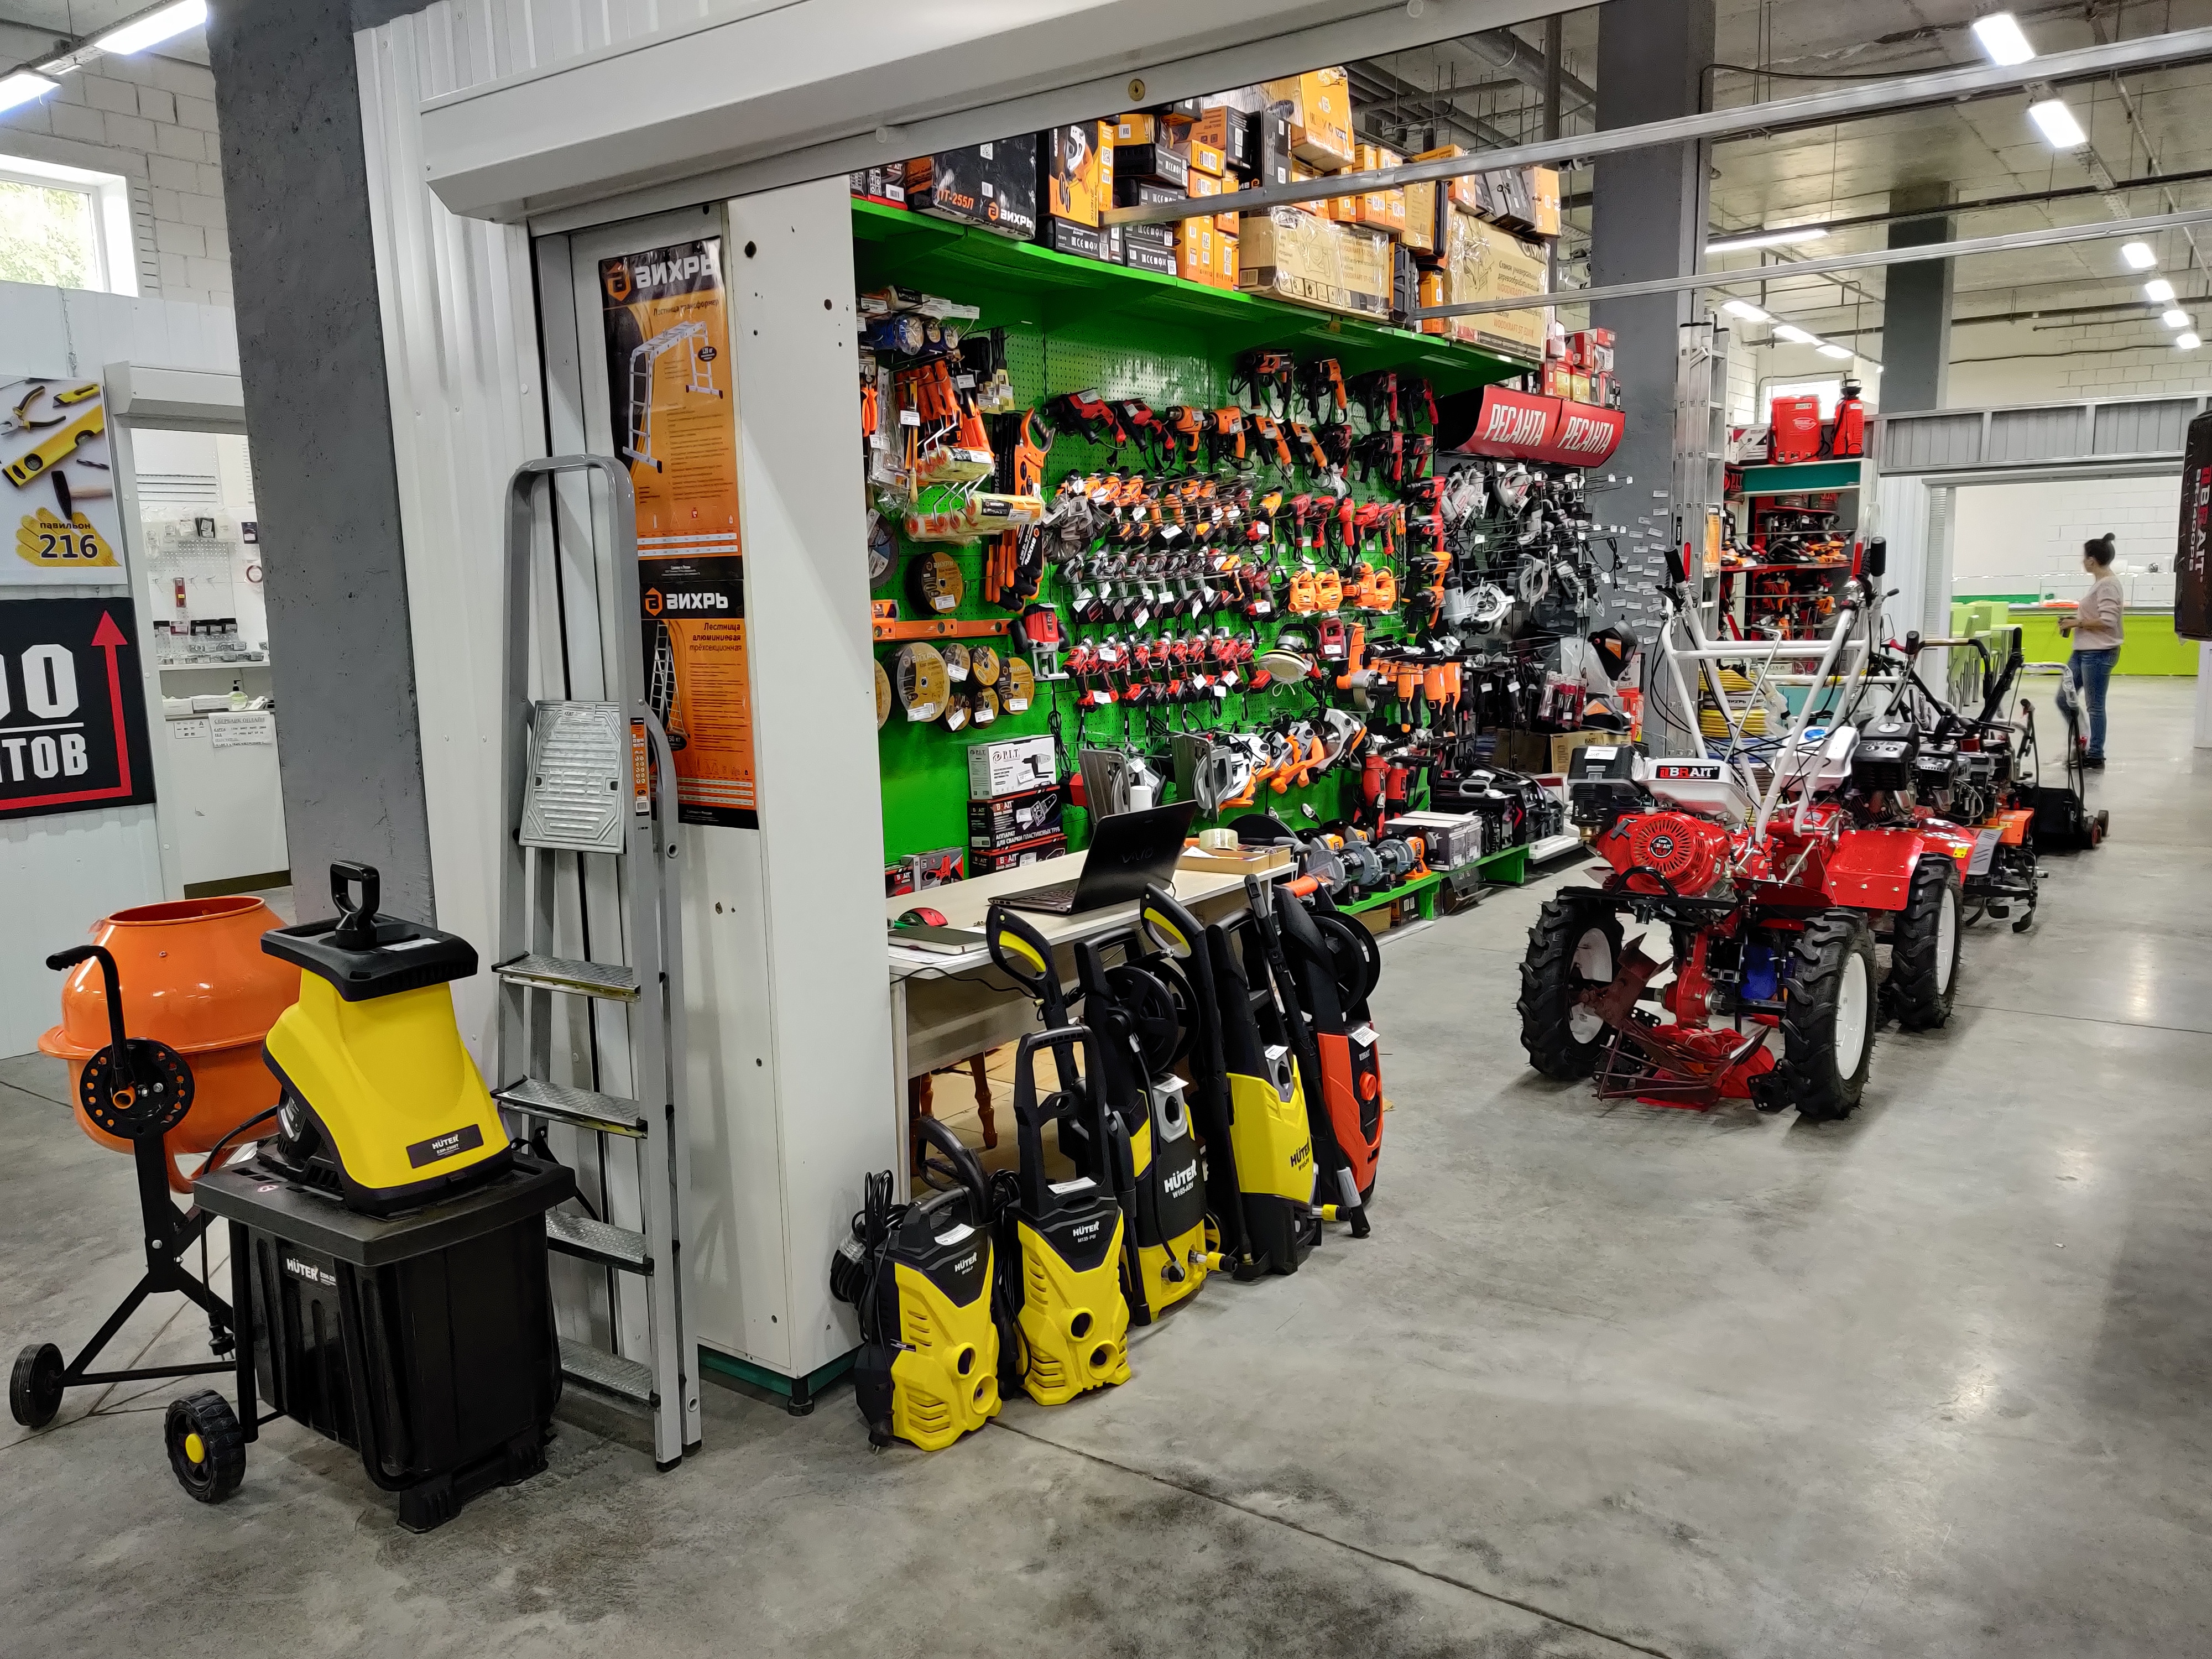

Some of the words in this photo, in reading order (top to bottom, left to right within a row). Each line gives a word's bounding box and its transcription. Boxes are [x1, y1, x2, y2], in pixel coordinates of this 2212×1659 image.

[1000, 208, 1035, 228] ВИХРЬ
[634, 255, 714, 289] ВИХРЬ
[1483, 404, 1546, 446] РЕСАНТА
[1557, 416, 1614, 454] РЕСАНТА
[2195, 484, 2210, 575] BRAIT
[40, 534, 98, 558] 216
[666, 592, 729, 609] ВИХРЬ
[703, 622, 740, 632] Лестница
[0, 733, 88, 783] ТОВ
[1669, 767, 1714, 777] BRAIT
[996, 831, 1015, 841] АППАРАТ
[1006, 837, 1022, 845] СВАРКИ
[1121, 848, 1154, 863] VAIO
[431, 1134, 459, 1150] HÜTER
[1290, 1136, 1310, 1167] HÜTER
[1164, 1159, 1197, 1193] HÜTER
[1073, 1221, 1099, 1237] HÜTER
[286, 1258, 319, 1281] HÜTER
[954, 1251, 977, 1272] HÜTER
